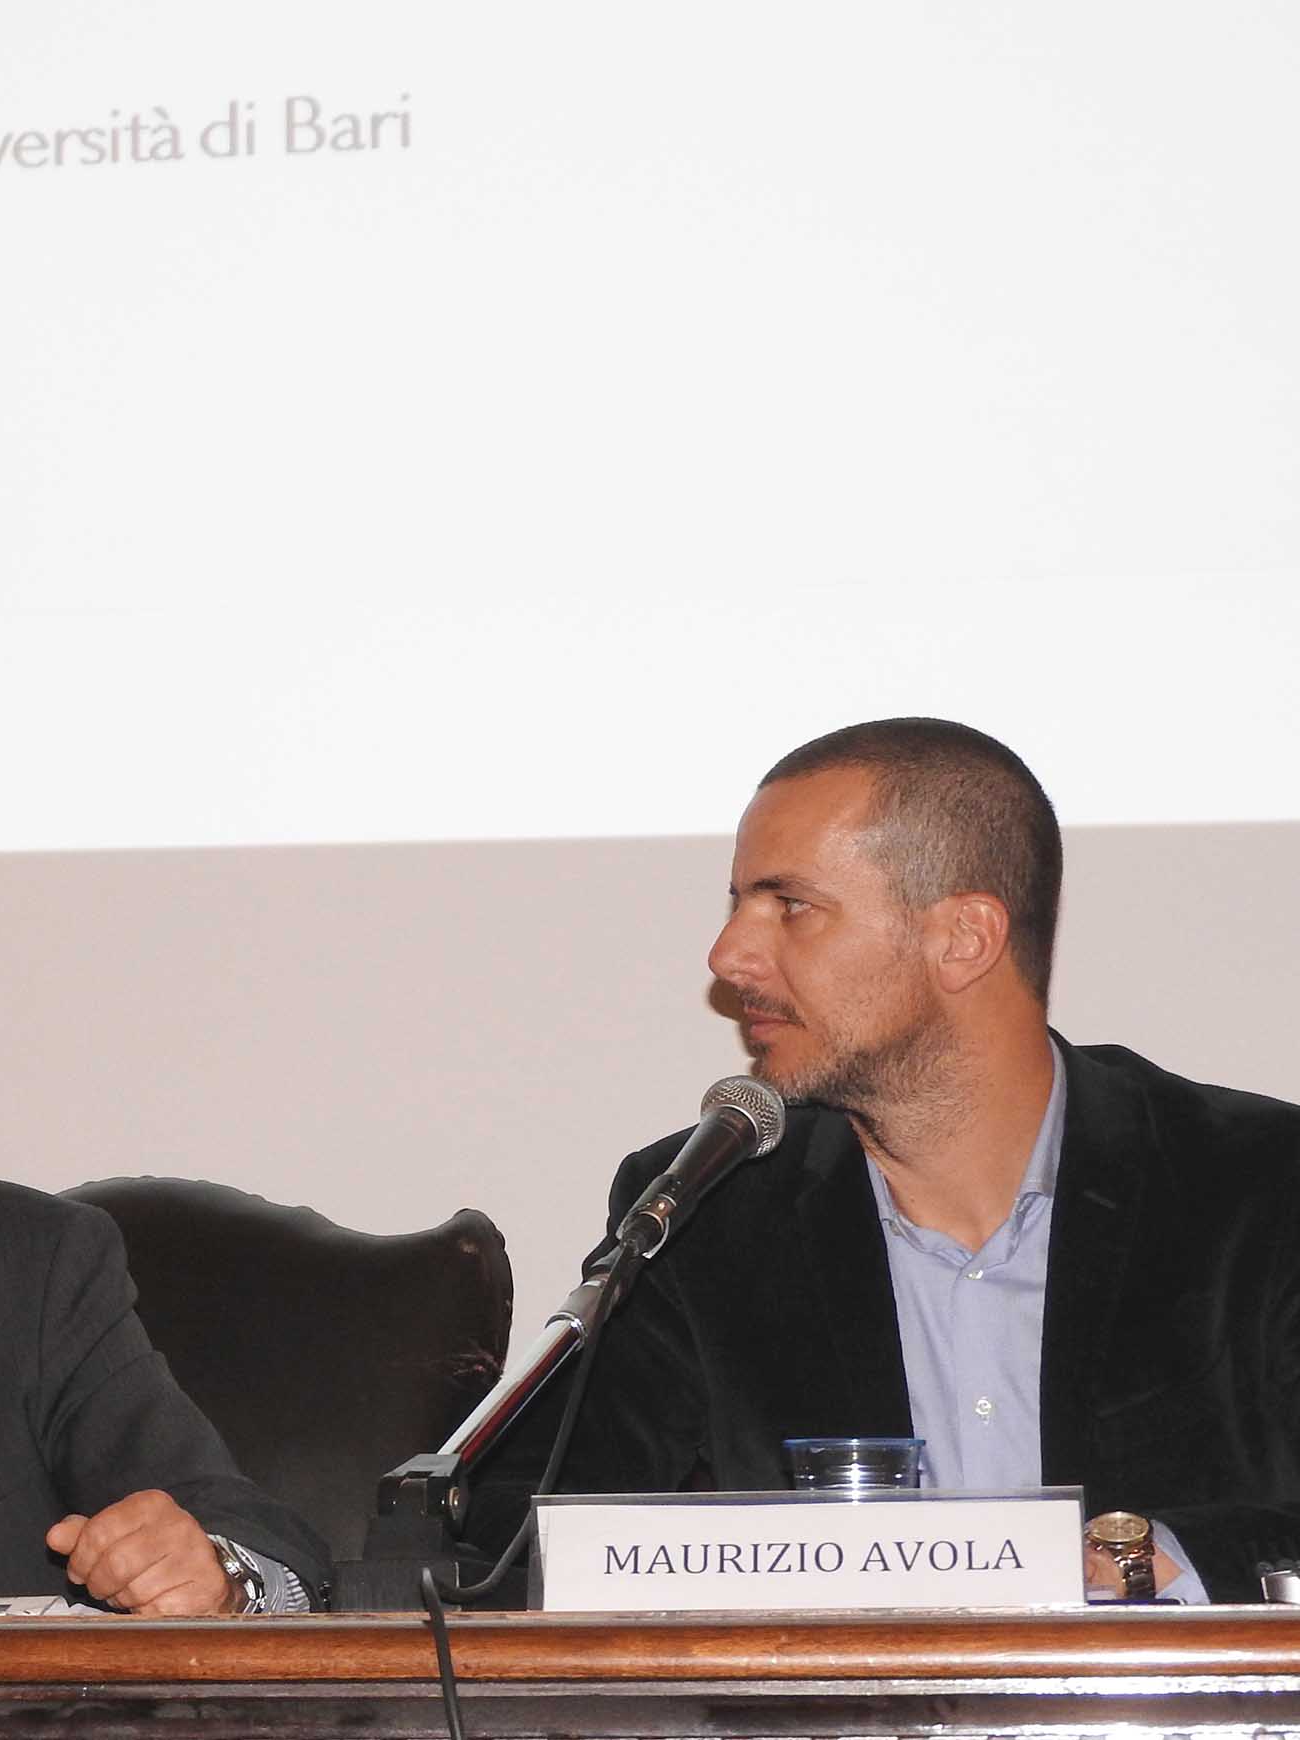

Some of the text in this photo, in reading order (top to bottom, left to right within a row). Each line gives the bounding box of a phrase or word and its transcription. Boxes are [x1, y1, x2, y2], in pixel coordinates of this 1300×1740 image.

[199, 99, 256, 159] di
[284, 92, 411, 155] Bari
[603, 1538, 1024, 1575] MAURIZIO AVOLA
